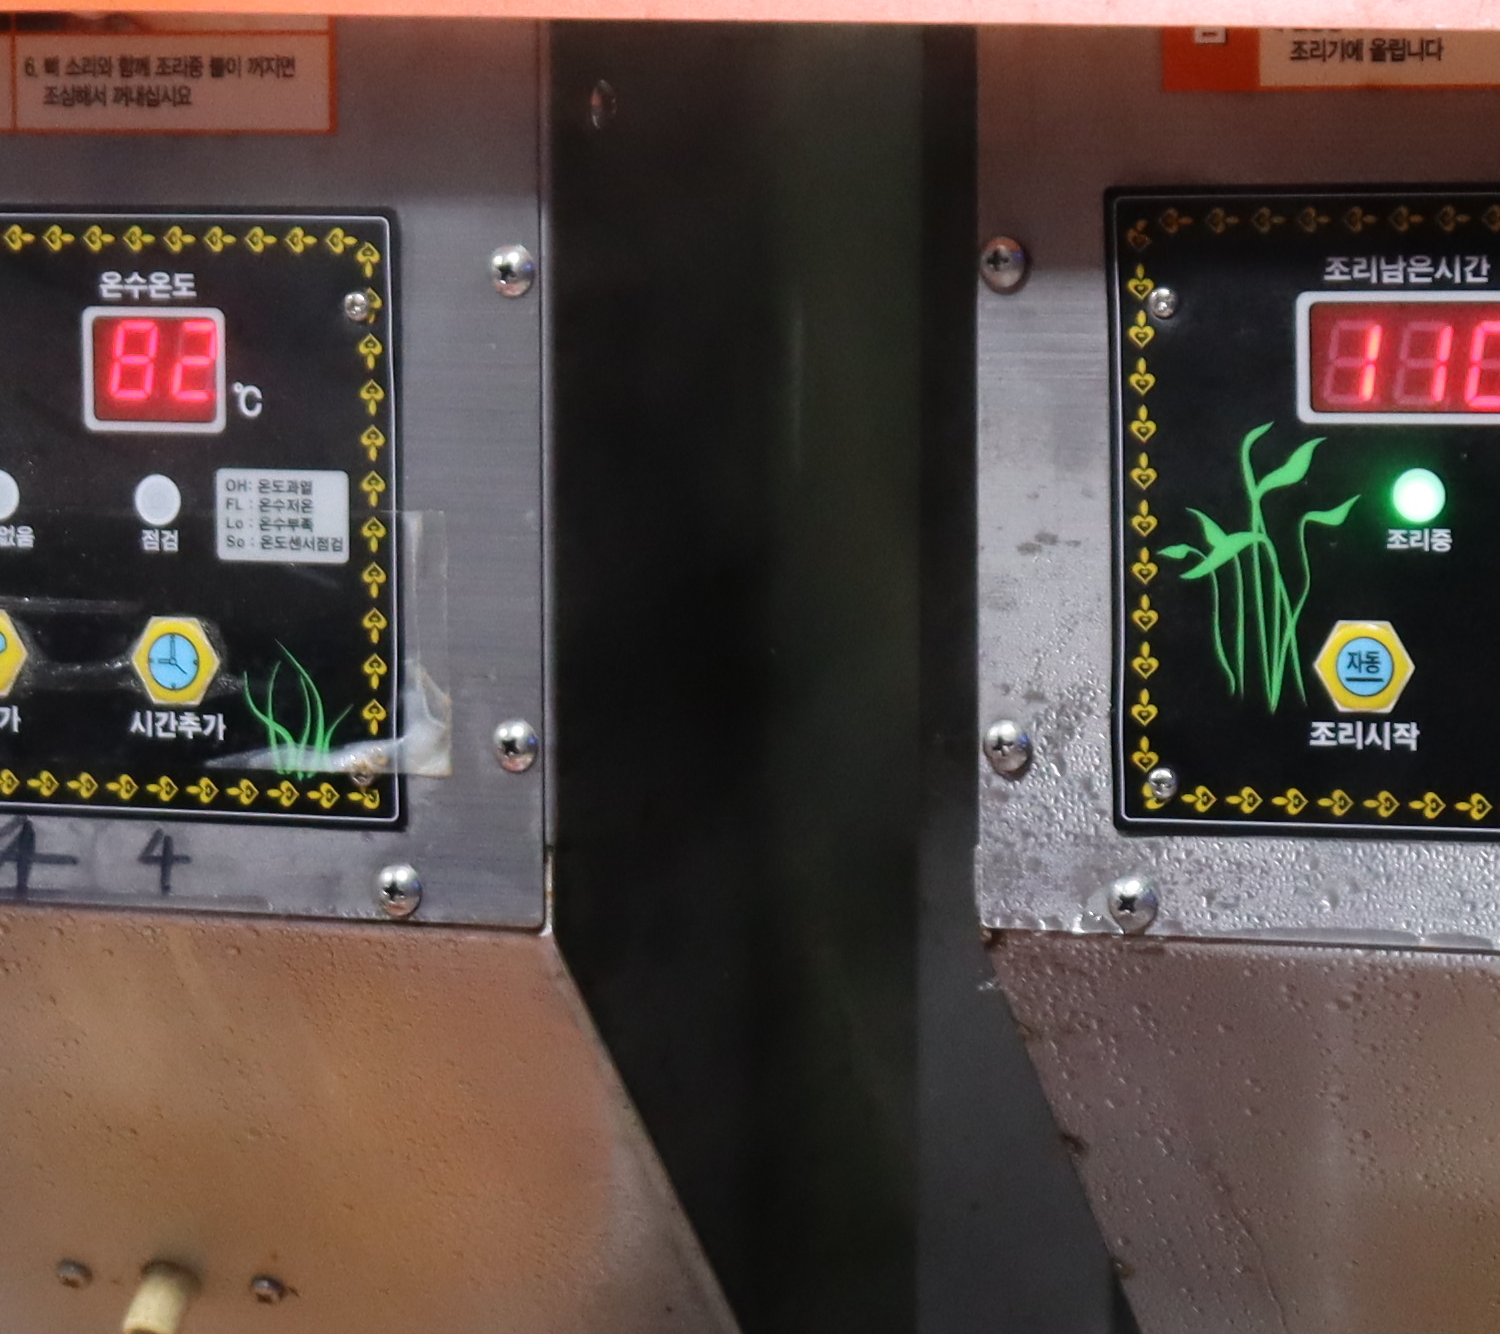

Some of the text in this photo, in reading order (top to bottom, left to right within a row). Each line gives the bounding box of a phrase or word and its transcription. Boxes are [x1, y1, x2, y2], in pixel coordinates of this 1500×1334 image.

[1290, 39, 1443, 62] 조리기에 올립니다
[1323, 256, 1491, 285] 조리남은시간
[98, 271, 197, 300] 온수온도
[106, 318, 220, 406] 82
[258, 478, 313, 495] 온도과열
[259, 498, 314, 512] 온수저온
[141, 522, 179, 553] 점검
[261, 535, 343, 552] 온도센서점검
[1386, 528, 1453, 553] 조리중
[1346, 651, 1381, 675] 자동
[129, 704, 227, 741] 시간추가
[1309, 720, 1421, 752] 조리시작
[138, 829, 192, 895] 4
